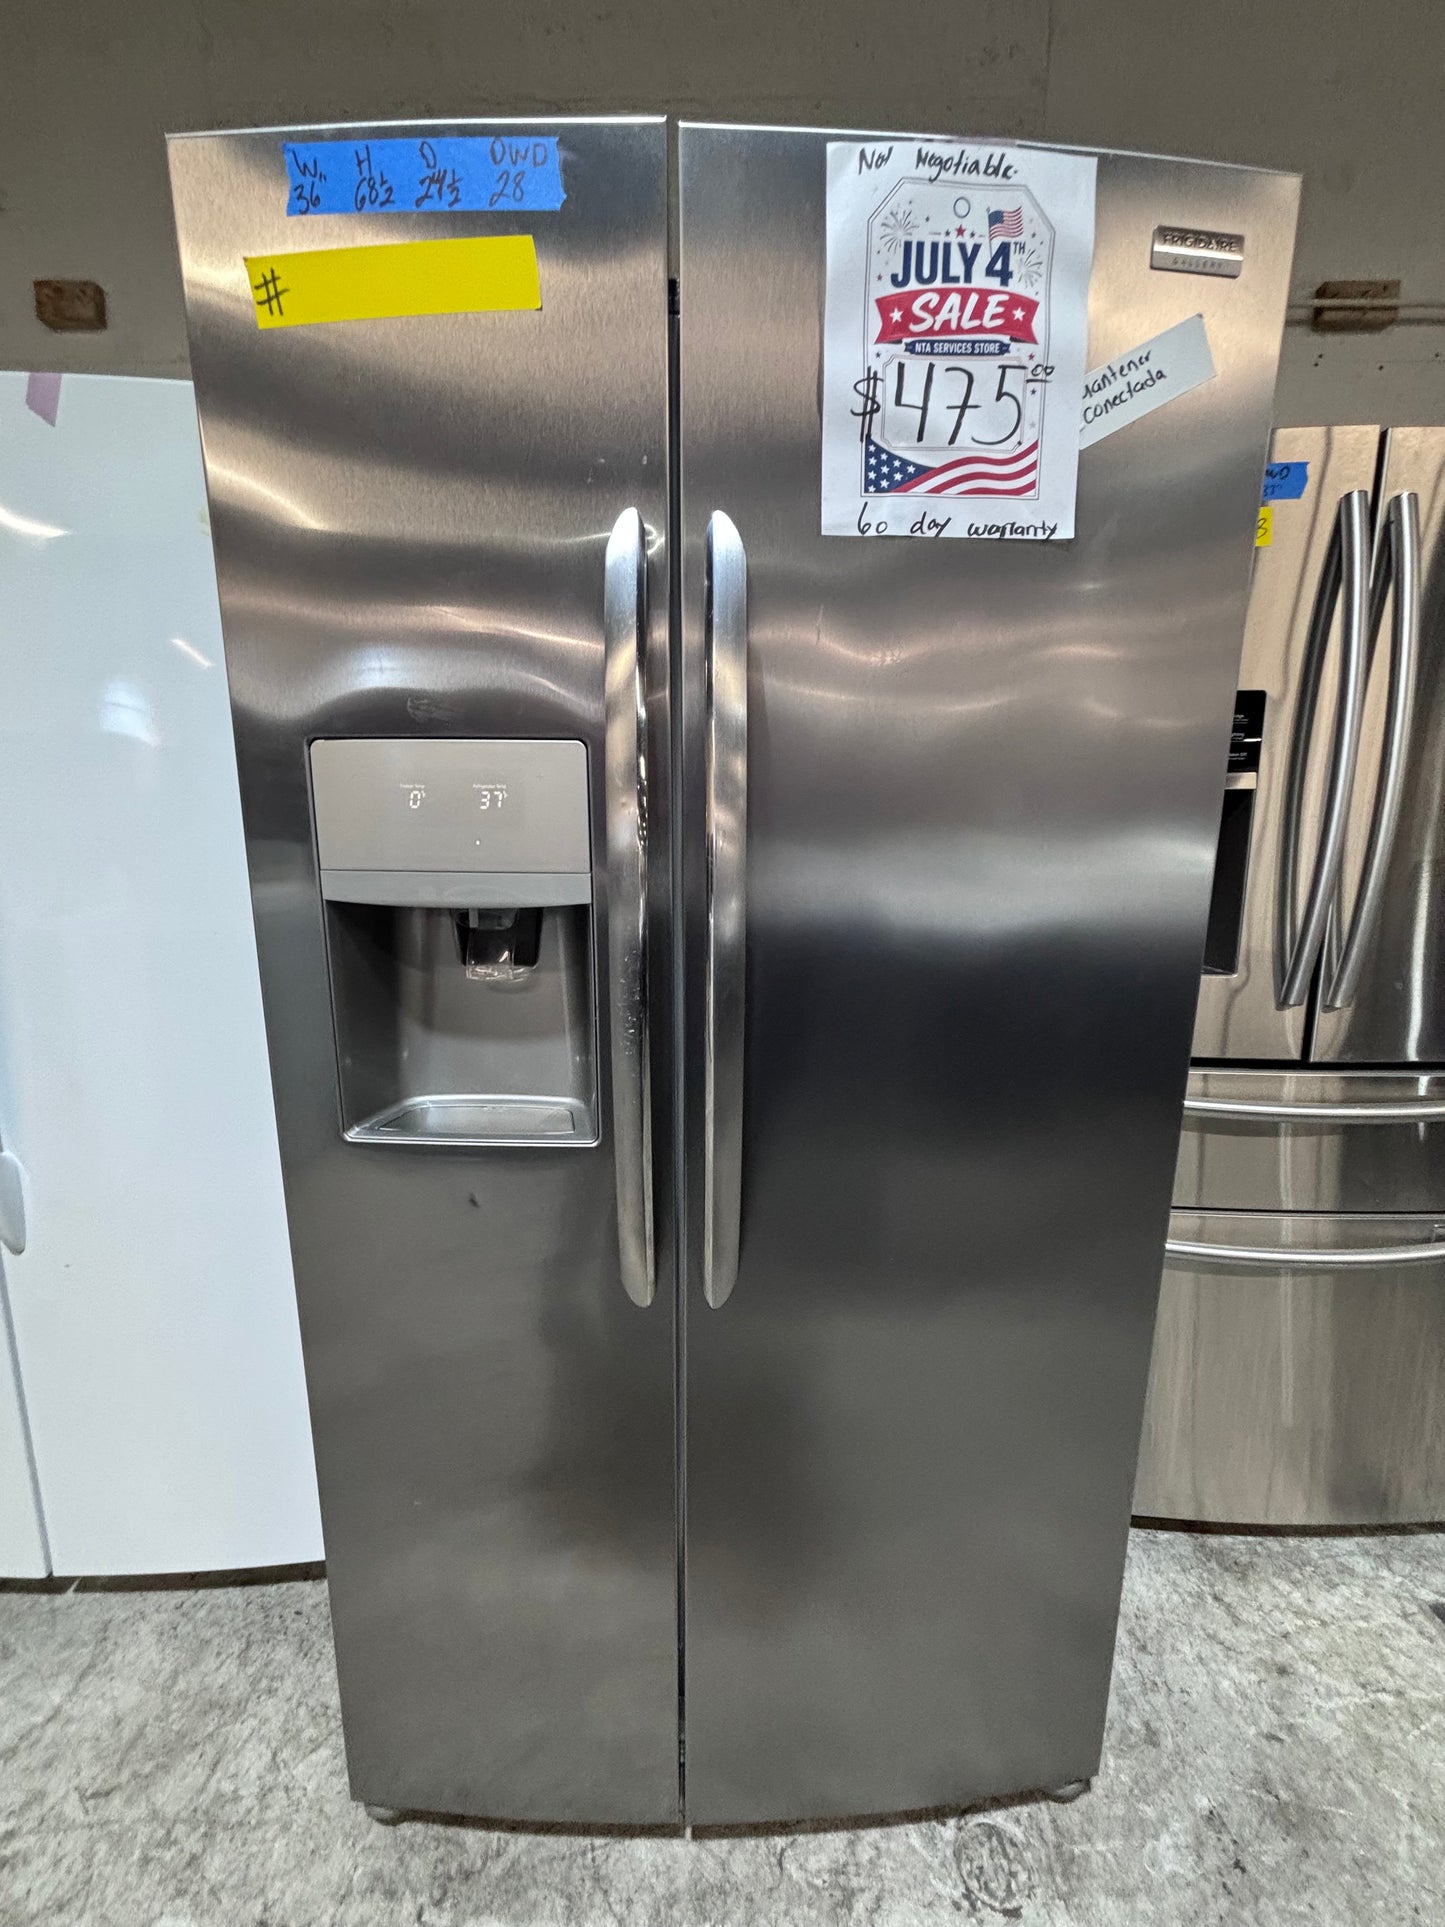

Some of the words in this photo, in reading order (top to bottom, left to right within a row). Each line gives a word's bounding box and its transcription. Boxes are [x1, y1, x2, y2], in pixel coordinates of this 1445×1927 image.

[291, 149, 318, 178] W
[355, 144, 372, 176] H
[489, 169, 526, 207] 28
[1161, 231, 1238, 252] FRIGIDAIRE
[890, 240, 982, 288] JULY
[254, 268, 289, 316] #
[908, 291, 1009, 333] SALE
[915, 342, 931, 354] NTA
[933, 342, 972, 354] SERVICES
[974, 342, 1000, 355] STORE
[858, 502, 888, 536] 60
[910, 511, 952, 537] day
